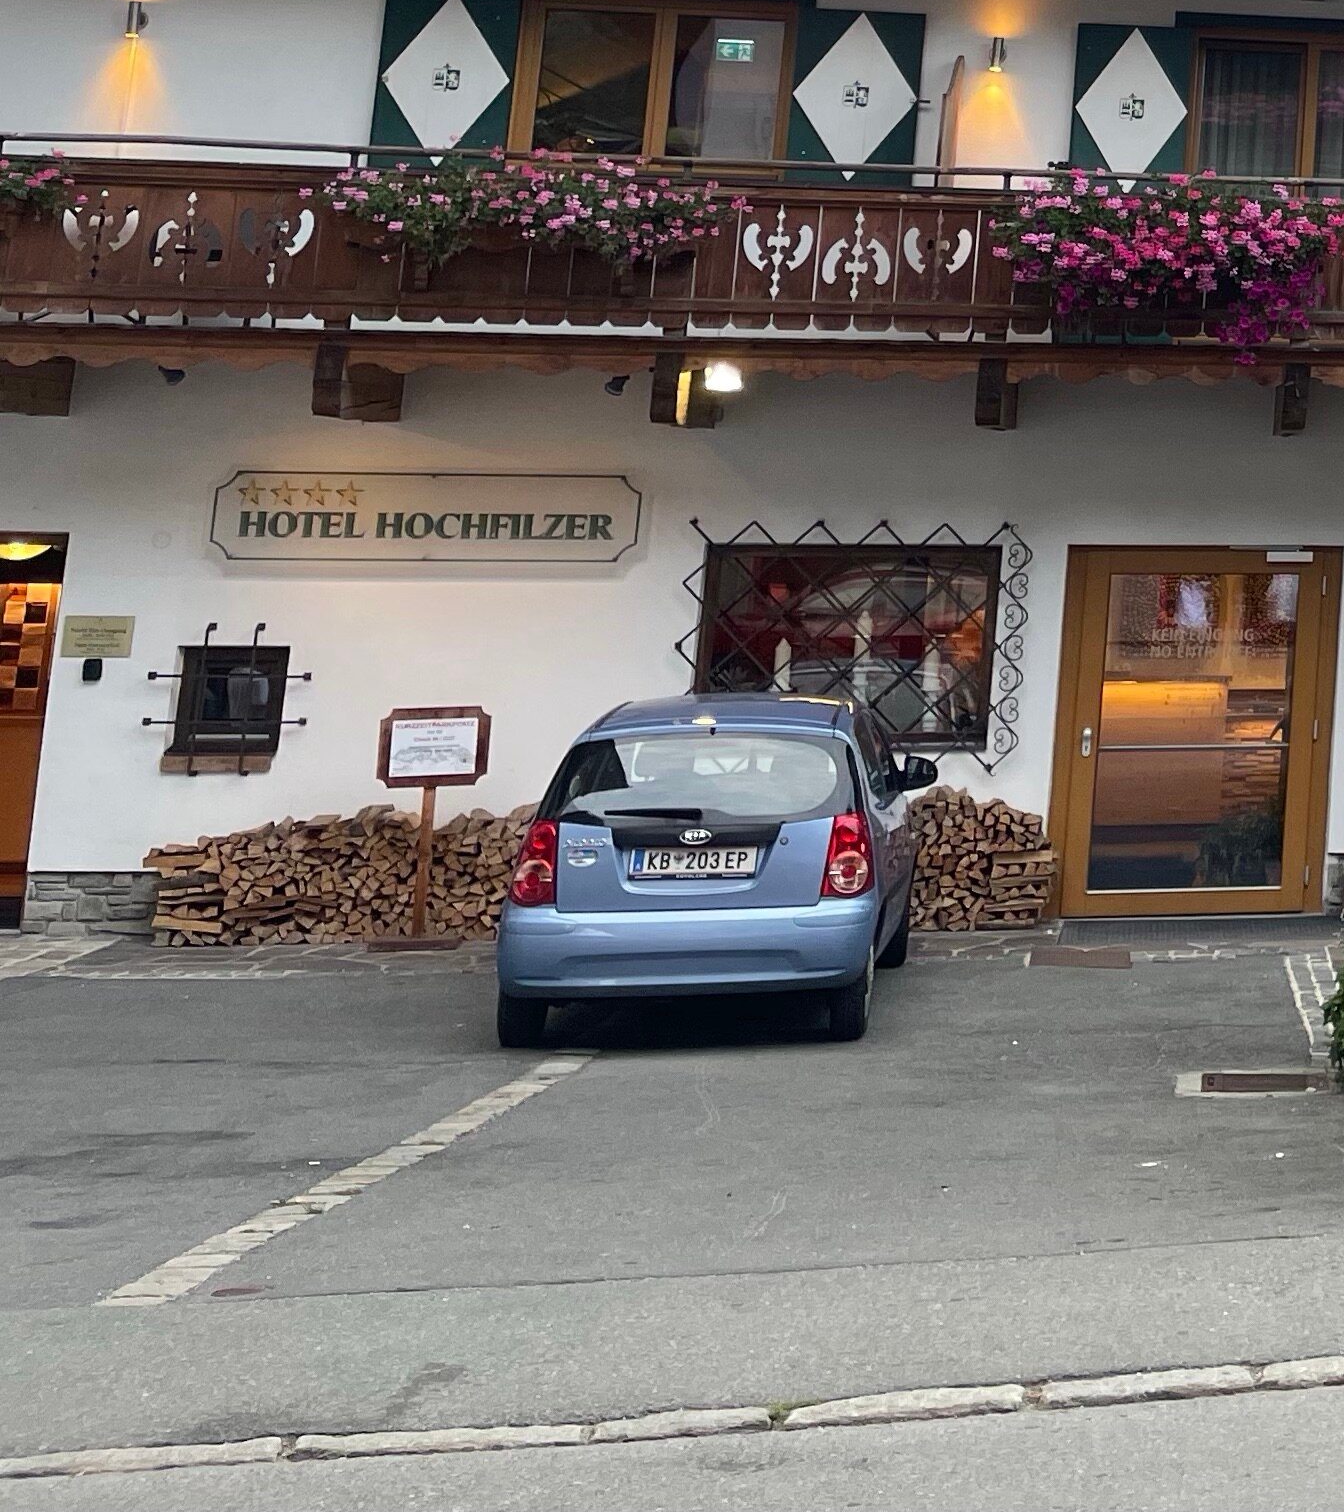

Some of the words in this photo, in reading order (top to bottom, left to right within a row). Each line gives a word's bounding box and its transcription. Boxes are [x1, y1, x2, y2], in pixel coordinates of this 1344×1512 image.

[237, 511, 365, 539] HOTEL
[375, 511, 615, 541] HOCHFILZER
[1190, 627, 1254, 643] EINGNG
[647, 852, 670, 870] KB
[685, 851, 720, 870] 203
[725, 851, 748, 870] EP
